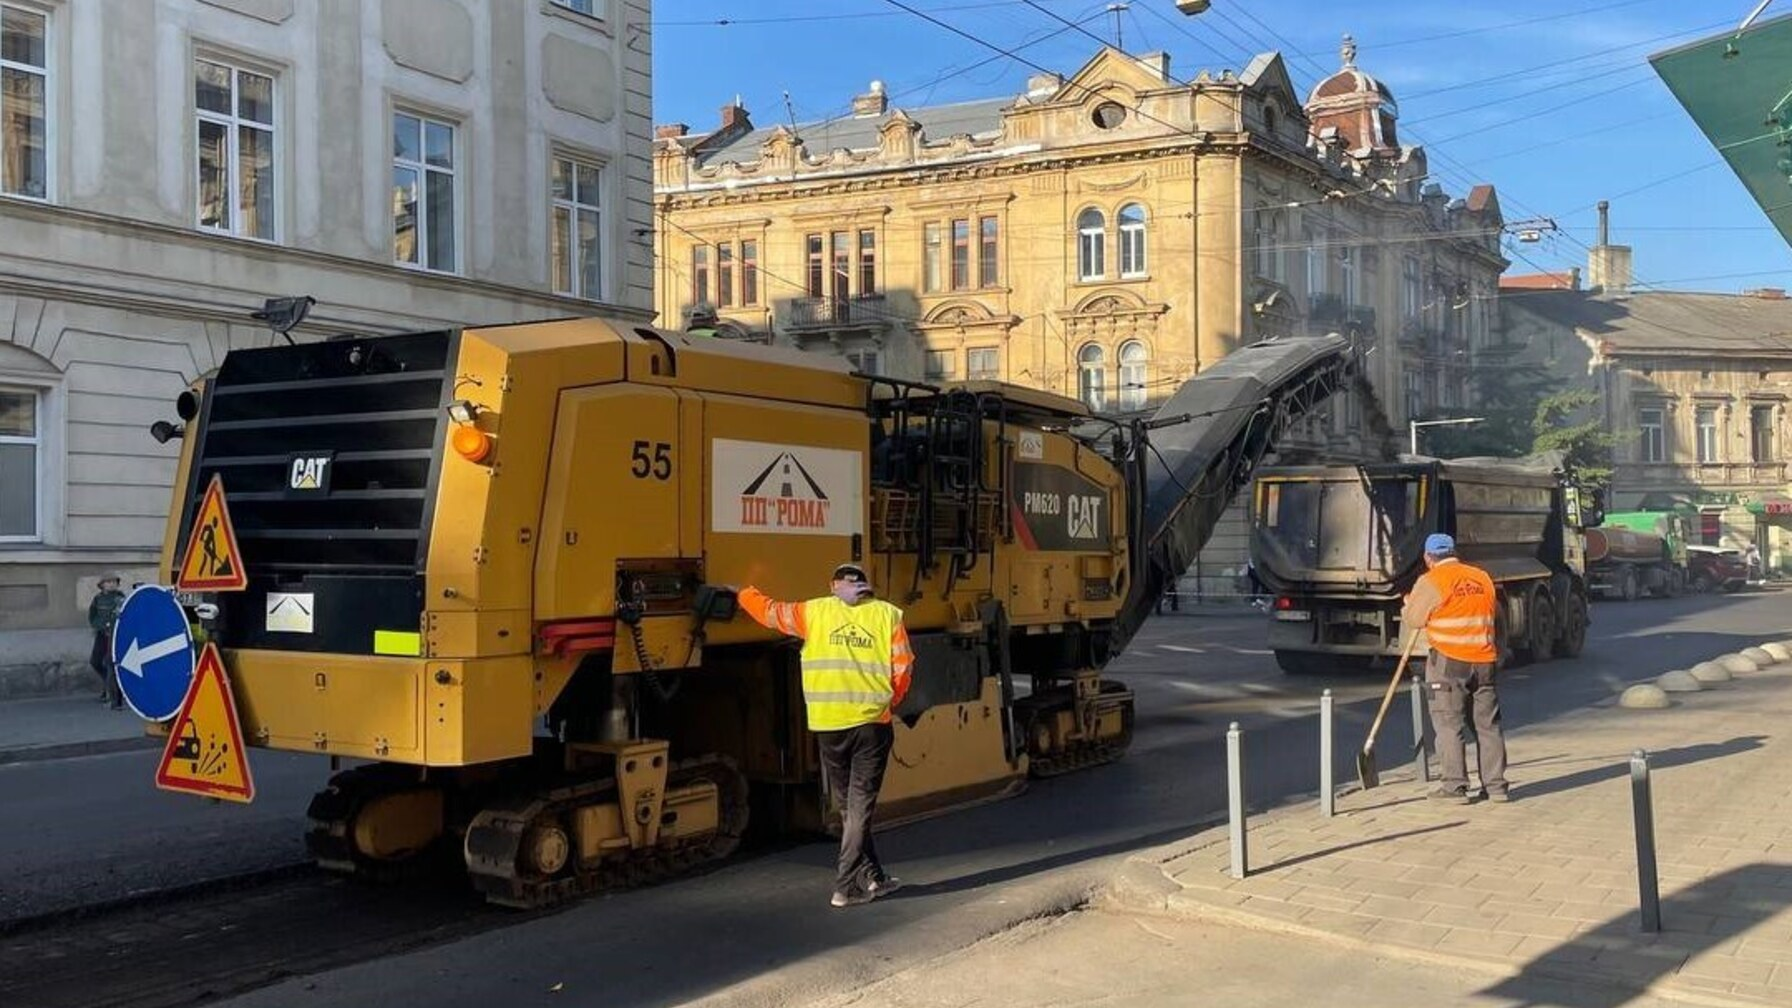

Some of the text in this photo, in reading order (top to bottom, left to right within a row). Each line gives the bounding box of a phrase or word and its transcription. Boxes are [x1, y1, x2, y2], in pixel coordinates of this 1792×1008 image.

[291, 457, 328, 488] CAT
[632, 441, 671, 480] 55
[1024, 491, 1060, 515] PM620
[1067, 494, 1101, 538] CAT
